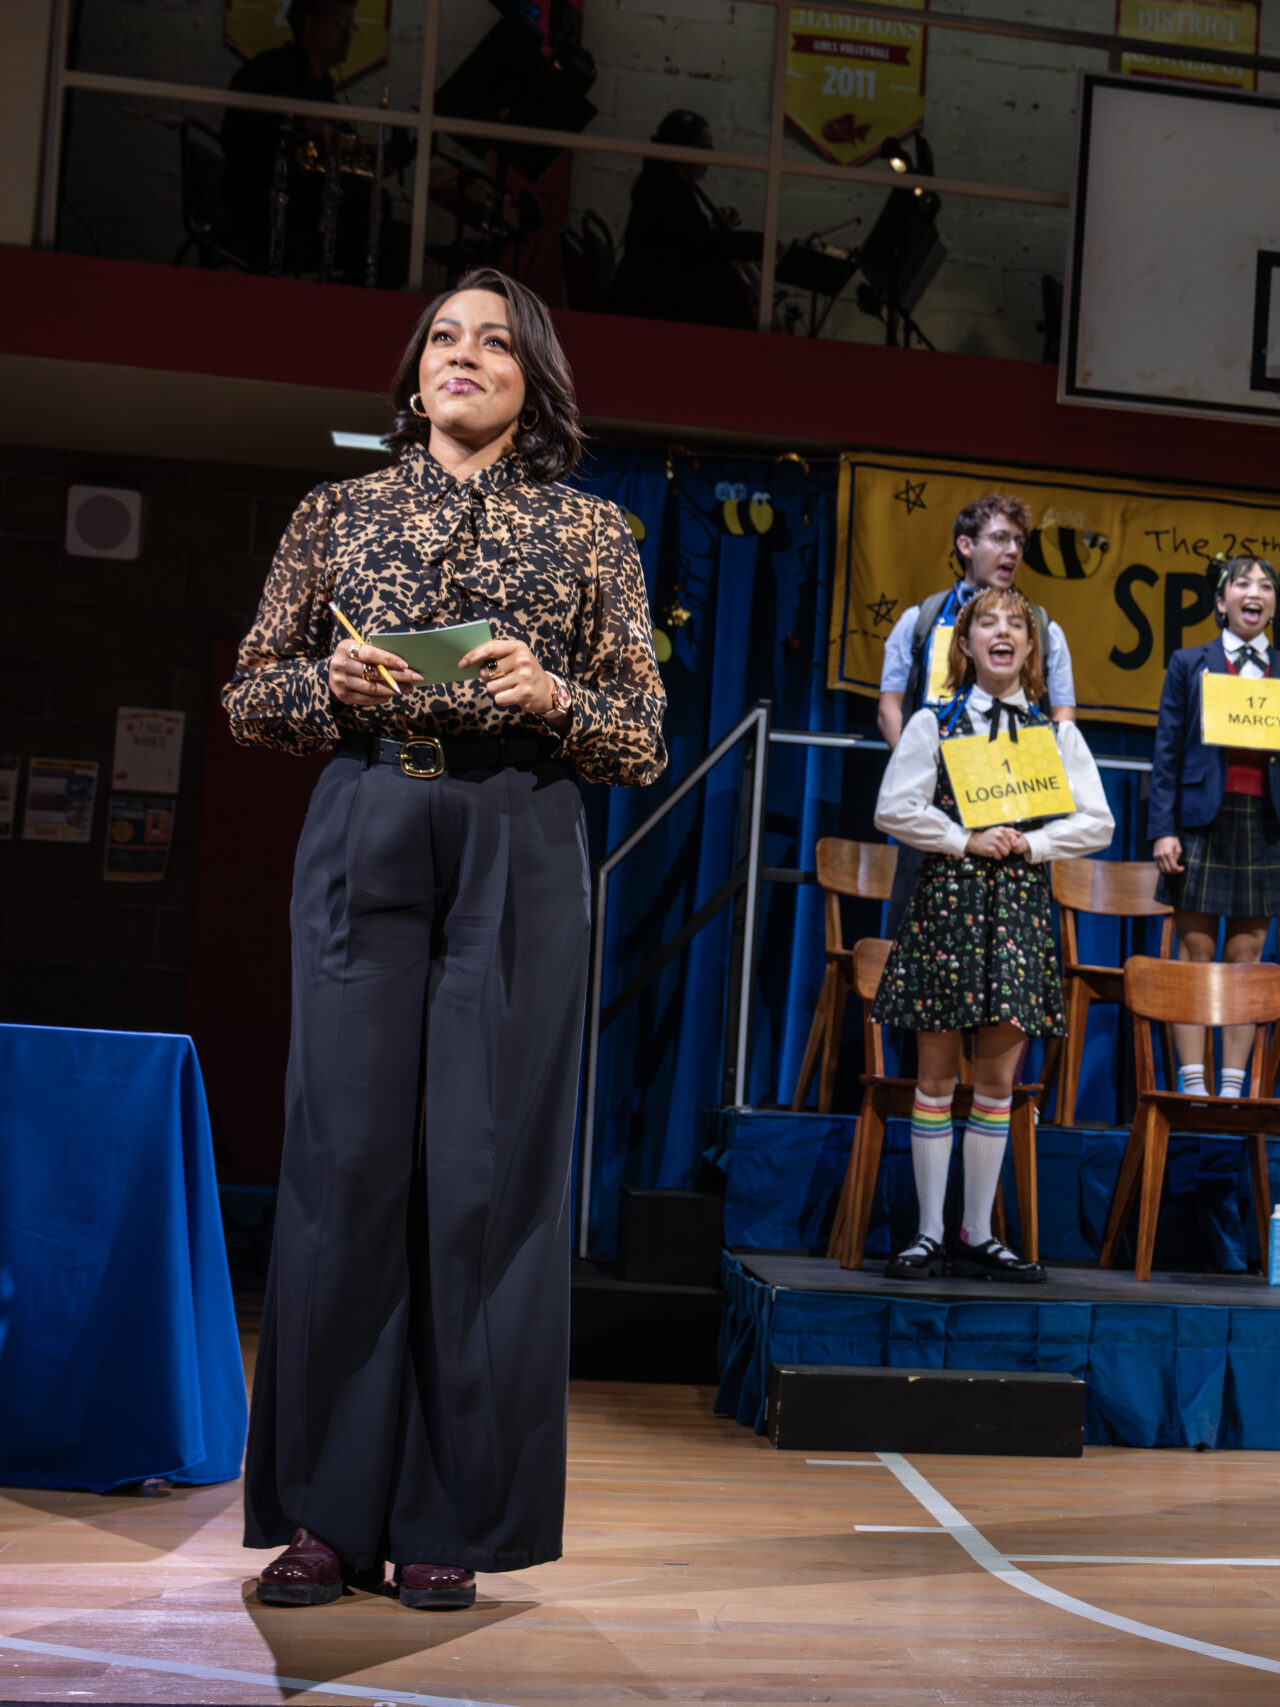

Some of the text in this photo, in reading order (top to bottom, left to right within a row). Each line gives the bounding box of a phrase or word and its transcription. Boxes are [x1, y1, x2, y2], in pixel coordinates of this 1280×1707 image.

[1138, 8, 1240, 43] DISTRICT
[839, 41, 890, 60] VOLLEYBALL
[821, 64, 876, 101] 2011
[1145, 527, 1211, 561] The
[1246, 696, 1267, 709] 17
[1001, 758, 1012, 775] 1
[965, 776, 1061, 803] LOGAINNE
